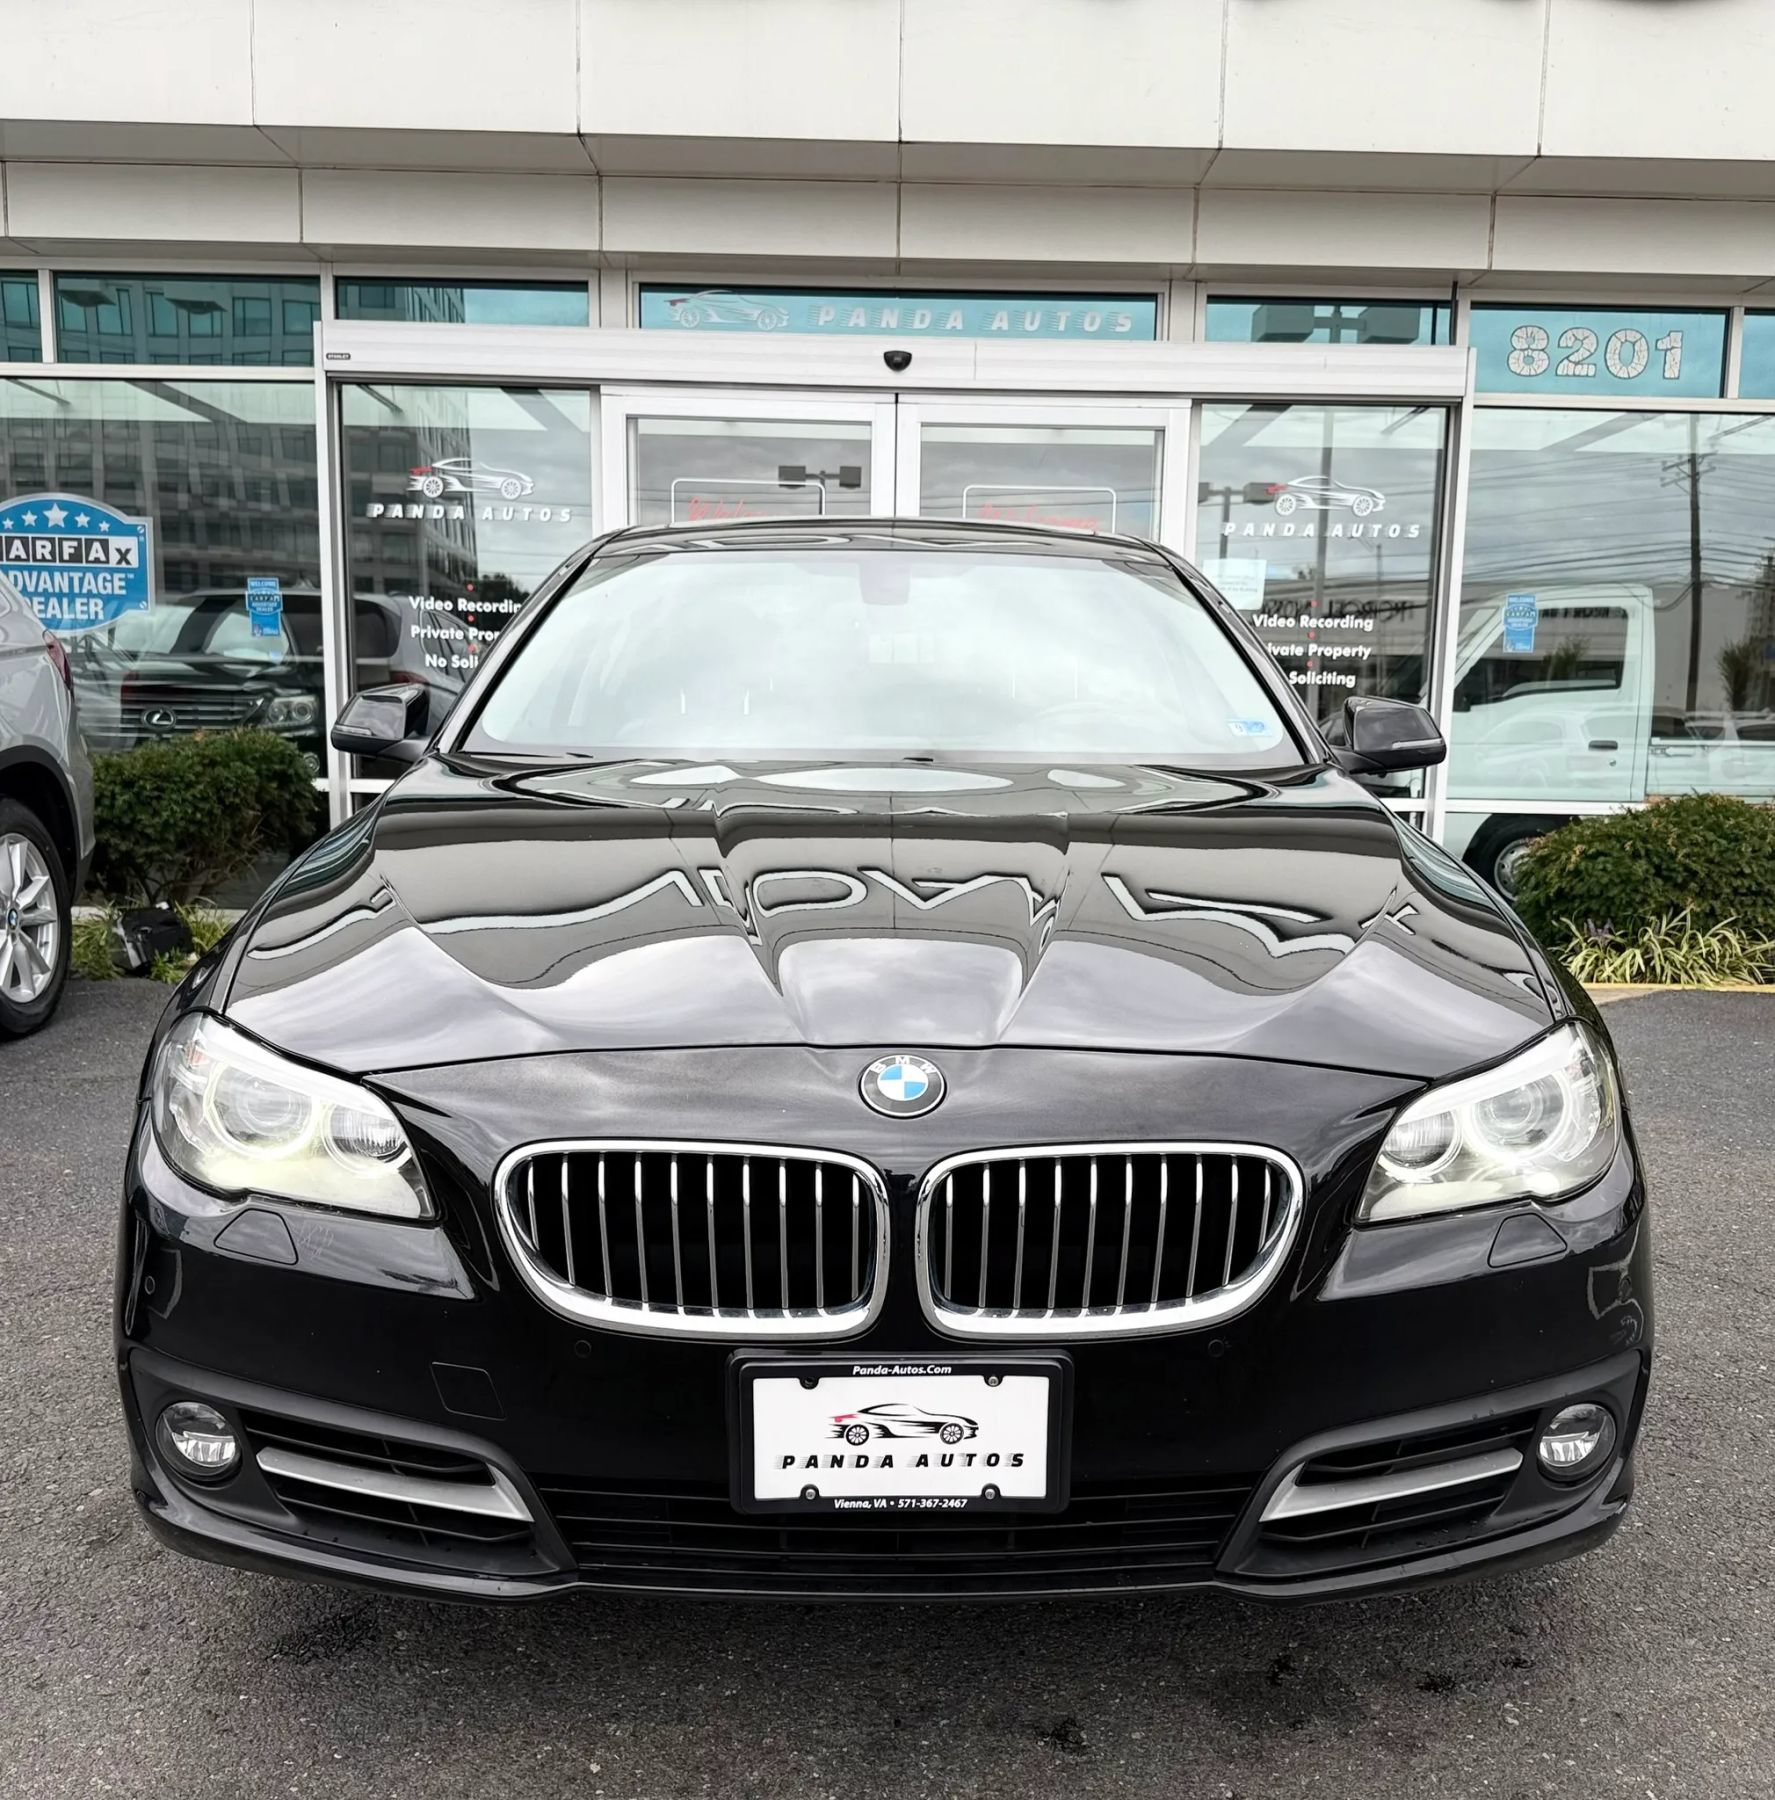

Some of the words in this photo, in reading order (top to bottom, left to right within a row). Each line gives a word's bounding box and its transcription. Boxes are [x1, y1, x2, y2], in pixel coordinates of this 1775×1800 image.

[817, 306, 963, 330] PANDA
[990, 311, 1132, 332] AUTOS
[1507, 325, 1684, 380] 8201
[372, 504, 464, 519] PANDA
[482, 507, 571, 522] AUTOS
[1223, 523, 1315, 537] PANDA
[1331, 524, 1420, 538] AUTOS
[9, 539, 132, 566] ARFAX
[8, 570, 127, 595] DVANTAGE
[409, 596, 454, 612] Video
[457, 598, 523, 614] Recordin
[1252, 613, 1296, 628] Video
[1300, 614, 1374, 632] Recording
[411, 625, 464, 640] Private
[1267, 642, 1305, 657] ivate
[1308, 643, 1372, 661] Property
[425, 654, 447, 668] No
[1288, 670, 1357, 689] Soliciting
[868, 1055, 938, 1074] BMW
[852, 1364, 952, 1376] Panda-Autos.Com
[775, 1454, 894, 1470] PANDA
[908, 1452, 1024, 1468] AUTOS
[834, 1499, 872, 1509] Vienna,
[873, 1499, 887, 1508] VA
[897, 1499, 968, 1508] 571-367-2467
